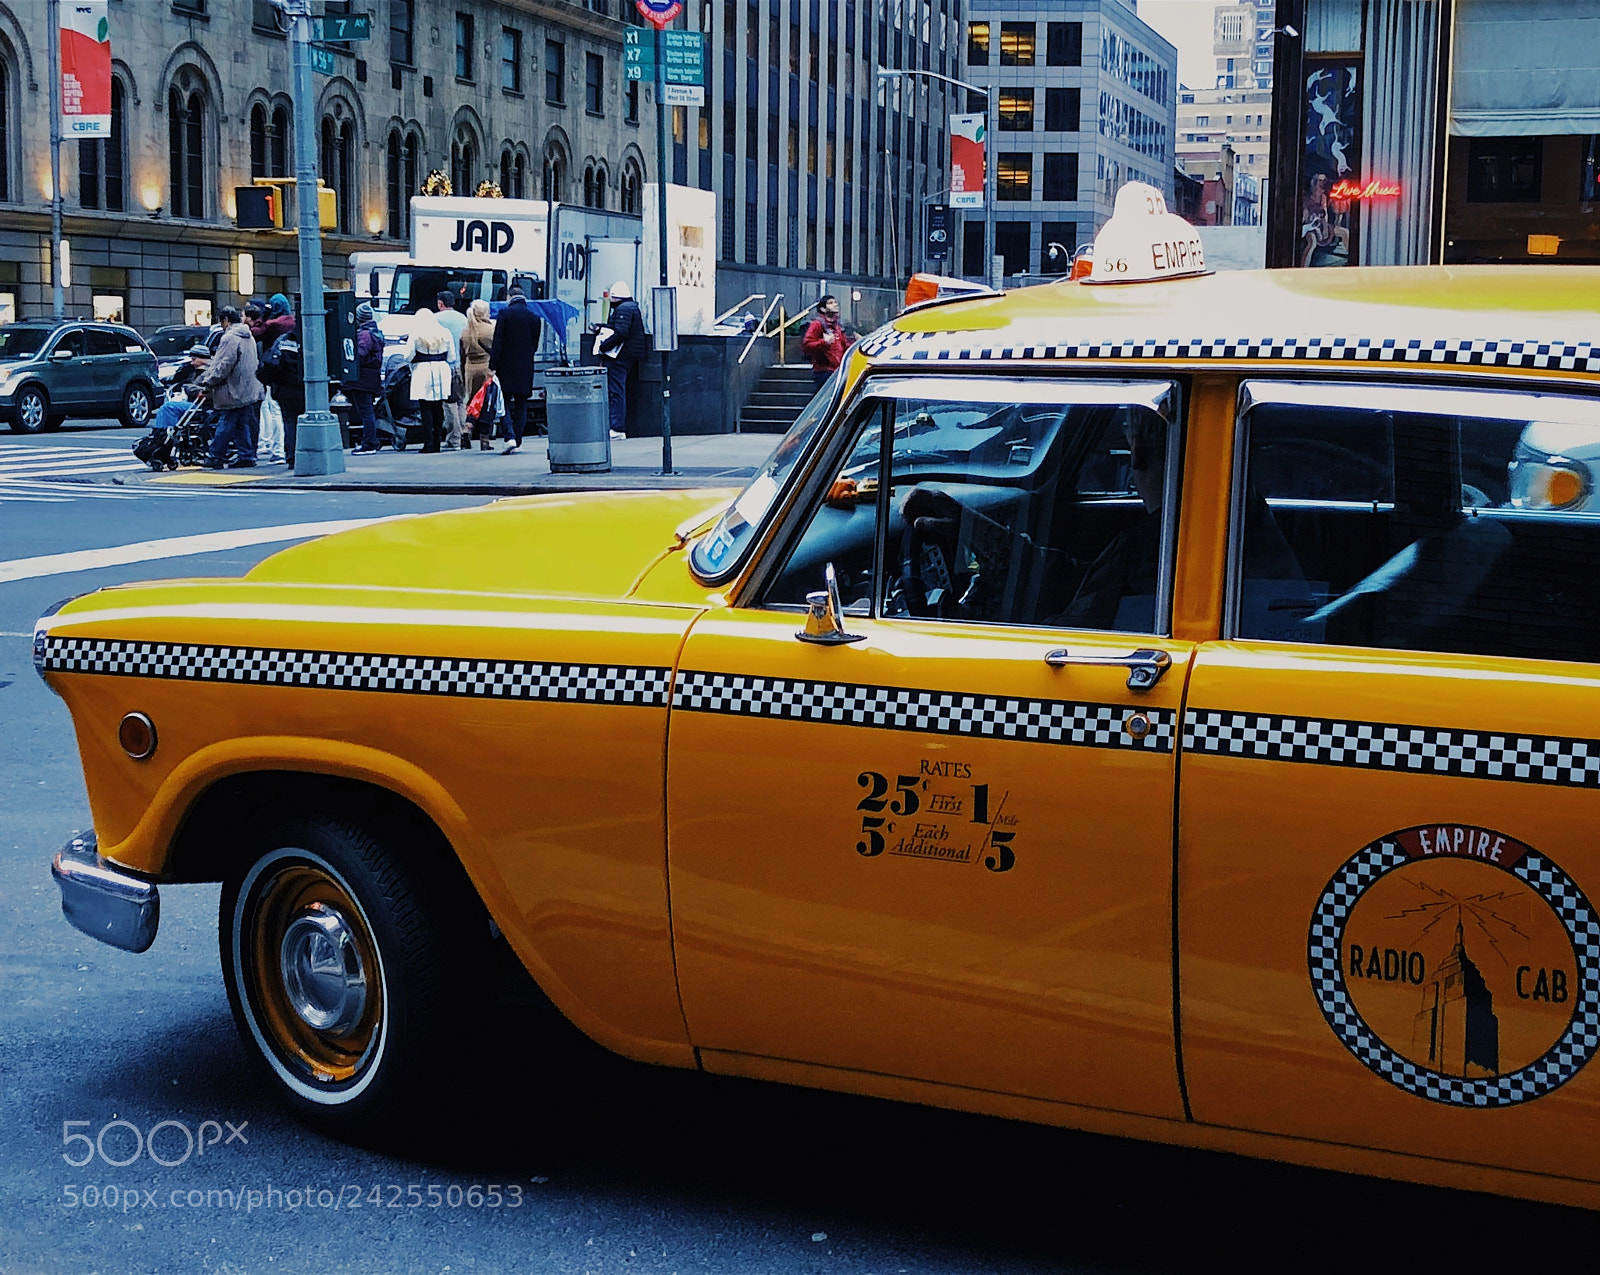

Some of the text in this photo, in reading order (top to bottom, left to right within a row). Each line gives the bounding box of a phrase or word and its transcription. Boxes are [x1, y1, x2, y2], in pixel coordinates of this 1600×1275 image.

[335, 19, 348, 37] 7
[72, 122, 101, 131] CBRE
[1357, 180, 1400, 198] Music
[451, 219, 514, 254] JAD
[558, 242, 585, 281] JAD
[1104, 258, 1128, 272] 56
[920, 759, 972, 778] RATES
[929, 794, 963, 812] First
[913, 823, 950, 841] Each
[890, 838, 972, 861] Additional
[1419, 827, 1506, 862] EMPIRE
[1350, 944, 1568, 1003] RADIO CAB
